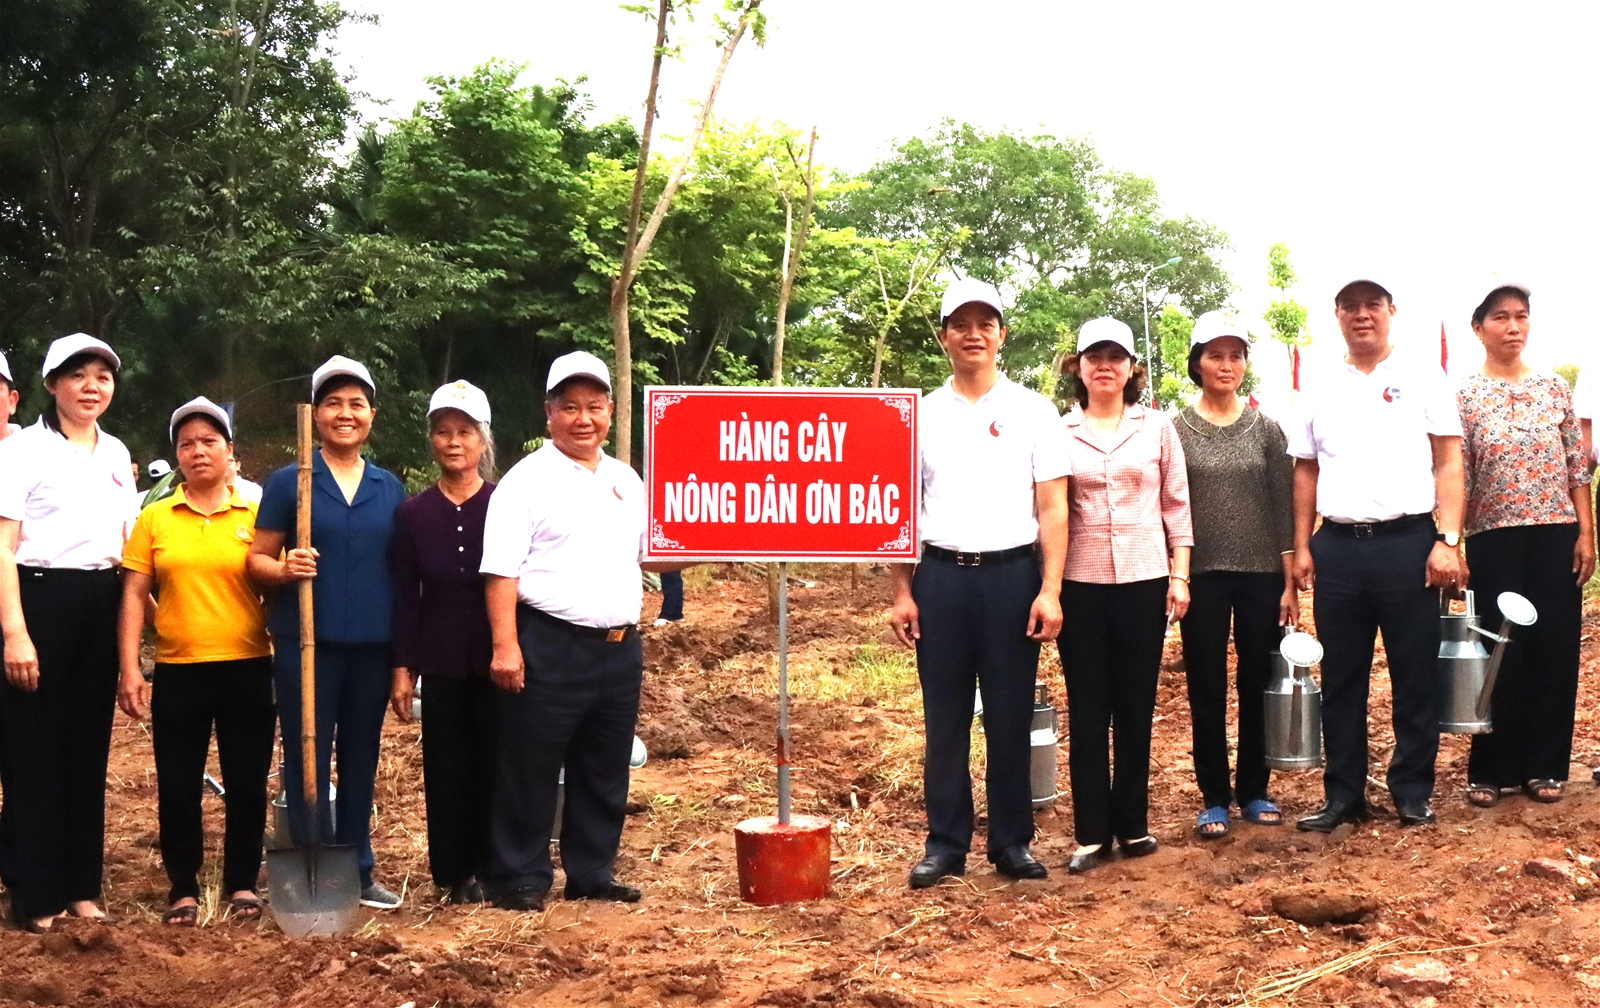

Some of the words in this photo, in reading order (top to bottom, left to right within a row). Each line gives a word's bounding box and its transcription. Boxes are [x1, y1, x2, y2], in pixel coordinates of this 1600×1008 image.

[719, 412, 790, 462] HÀNG
[798, 412, 848, 463] CÂY
[664, 473, 737, 523] NÔNG
[744, 473, 798, 524] DÂN
[805, 478, 841, 524] ƠN
[849, 474, 900, 525] BÁC
